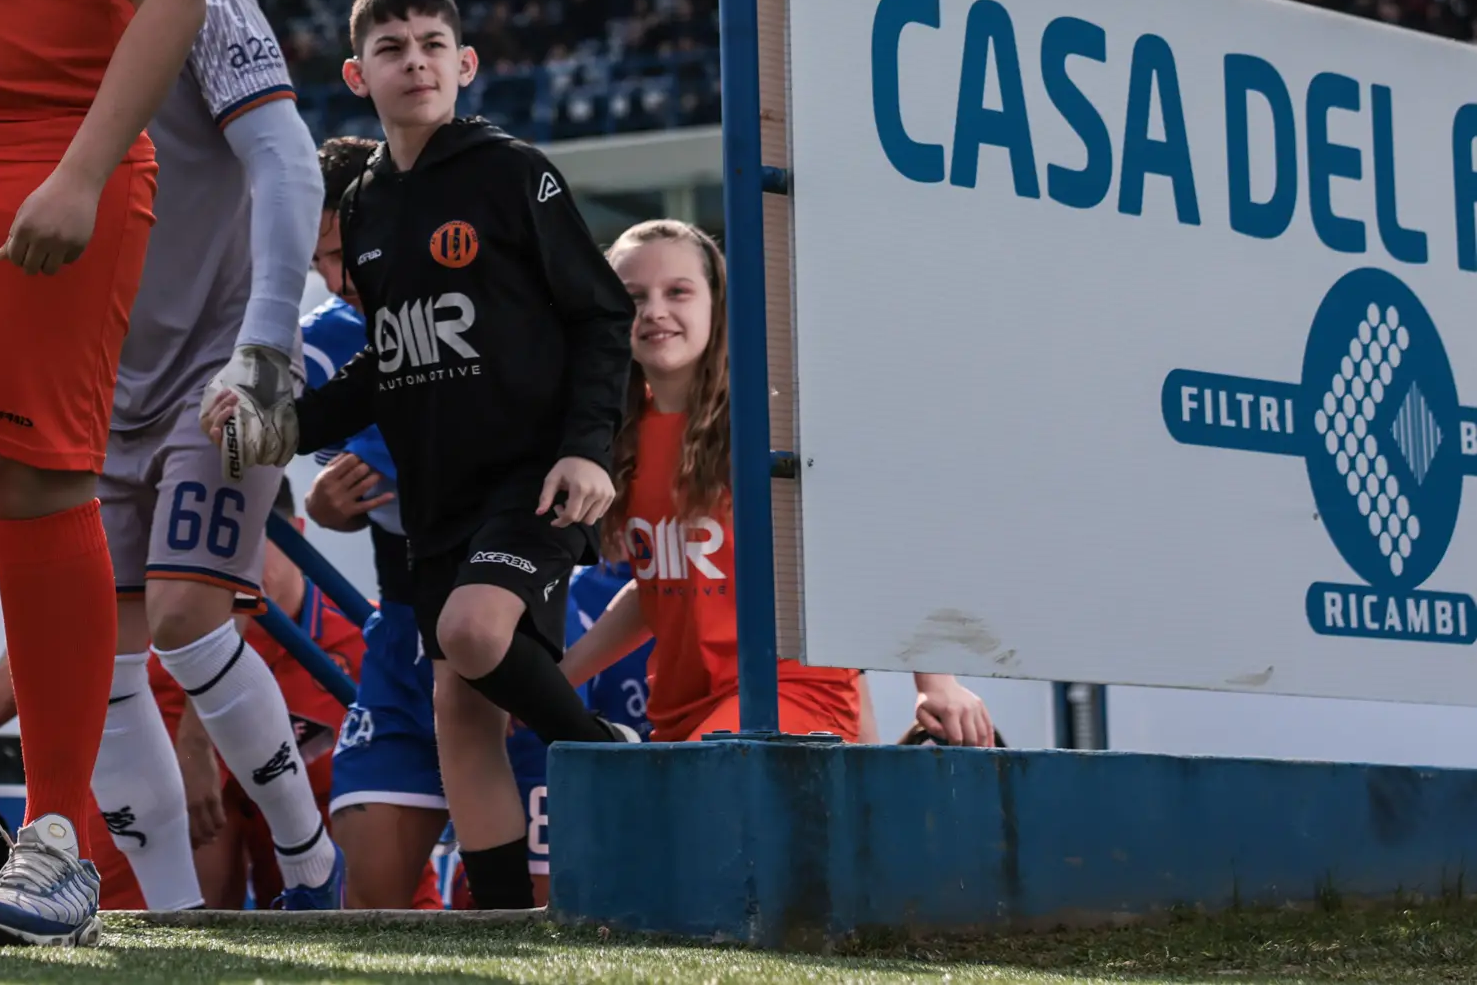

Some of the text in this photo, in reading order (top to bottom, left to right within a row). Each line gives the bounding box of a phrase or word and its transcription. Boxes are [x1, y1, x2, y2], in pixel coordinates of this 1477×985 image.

[227, 36, 281, 69] a2a
[1224, 52, 1429, 264] DEL
[378, 365, 482, 392] AUTOMOTIVE
[1181, 385, 1294, 434] FILTRI
[225, 415, 240, 479] reusch
[167, 481, 245, 558] 66
[470, 551, 537, 574] ACERBIS
[1324, 591, 1467, 636] RICAMBI
